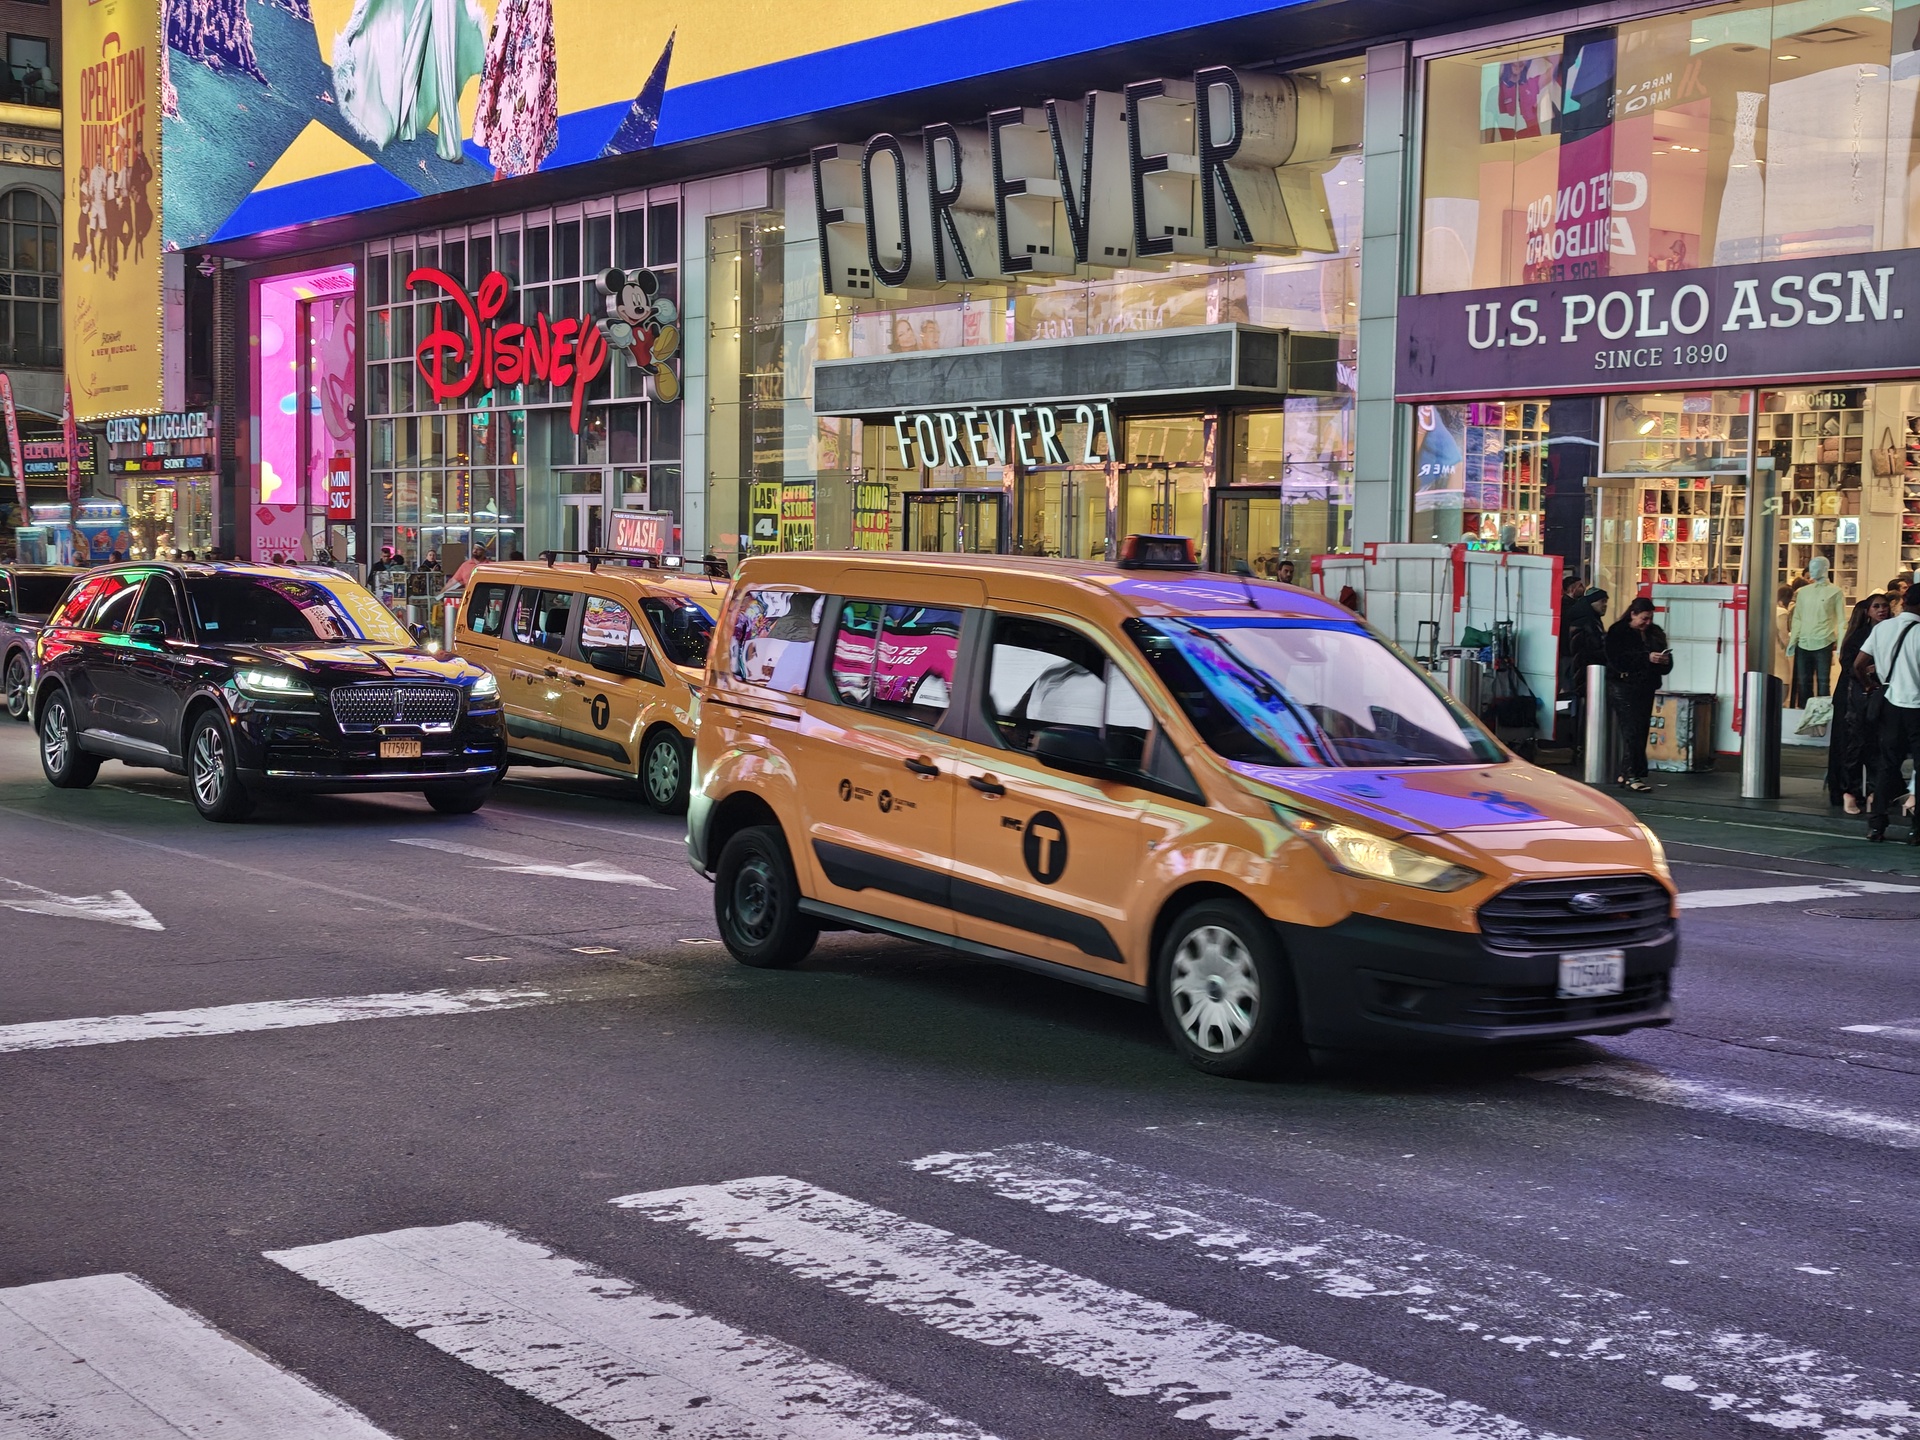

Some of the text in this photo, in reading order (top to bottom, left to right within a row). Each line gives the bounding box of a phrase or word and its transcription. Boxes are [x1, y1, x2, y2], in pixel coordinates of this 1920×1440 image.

[81, 46, 145, 122] OPERATION
[811, 65, 1254, 296] FOREVER
[1465, 267, 1905, 350] U.S. POLO ASSN.
[111, 344, 137, 355] MUSICAL
[1594, 344, 1728, 370] SINCE 1890
[106, 412, 207, 443] GIFTS LUGGAGE
[894, 403, 1116, 468] FOREVER 21
[24, 441, 90, 459] ELECTROCS
[25, 462, 55, 473] CAMERA
[164, 459, 185, 469] SONY
[331, 471, 350, 487] MINI
[754, 487, 777, 509] LAST
[783, 484, 815, 500] ENTIRE
[856, 484, 889, 510] GOING
[783, 502, 815, 518] STORE
[755, 518, 774, 537] 4
[856, 511, 888, 530] OUT OF
[256, 536, 300, 549] BLIND
[617, 519, 658, 548] SMASH
[596, 700, 607, 726] T
[383, 742, 418, 755] T775921C
[1032, 824, 1061, 875] T
